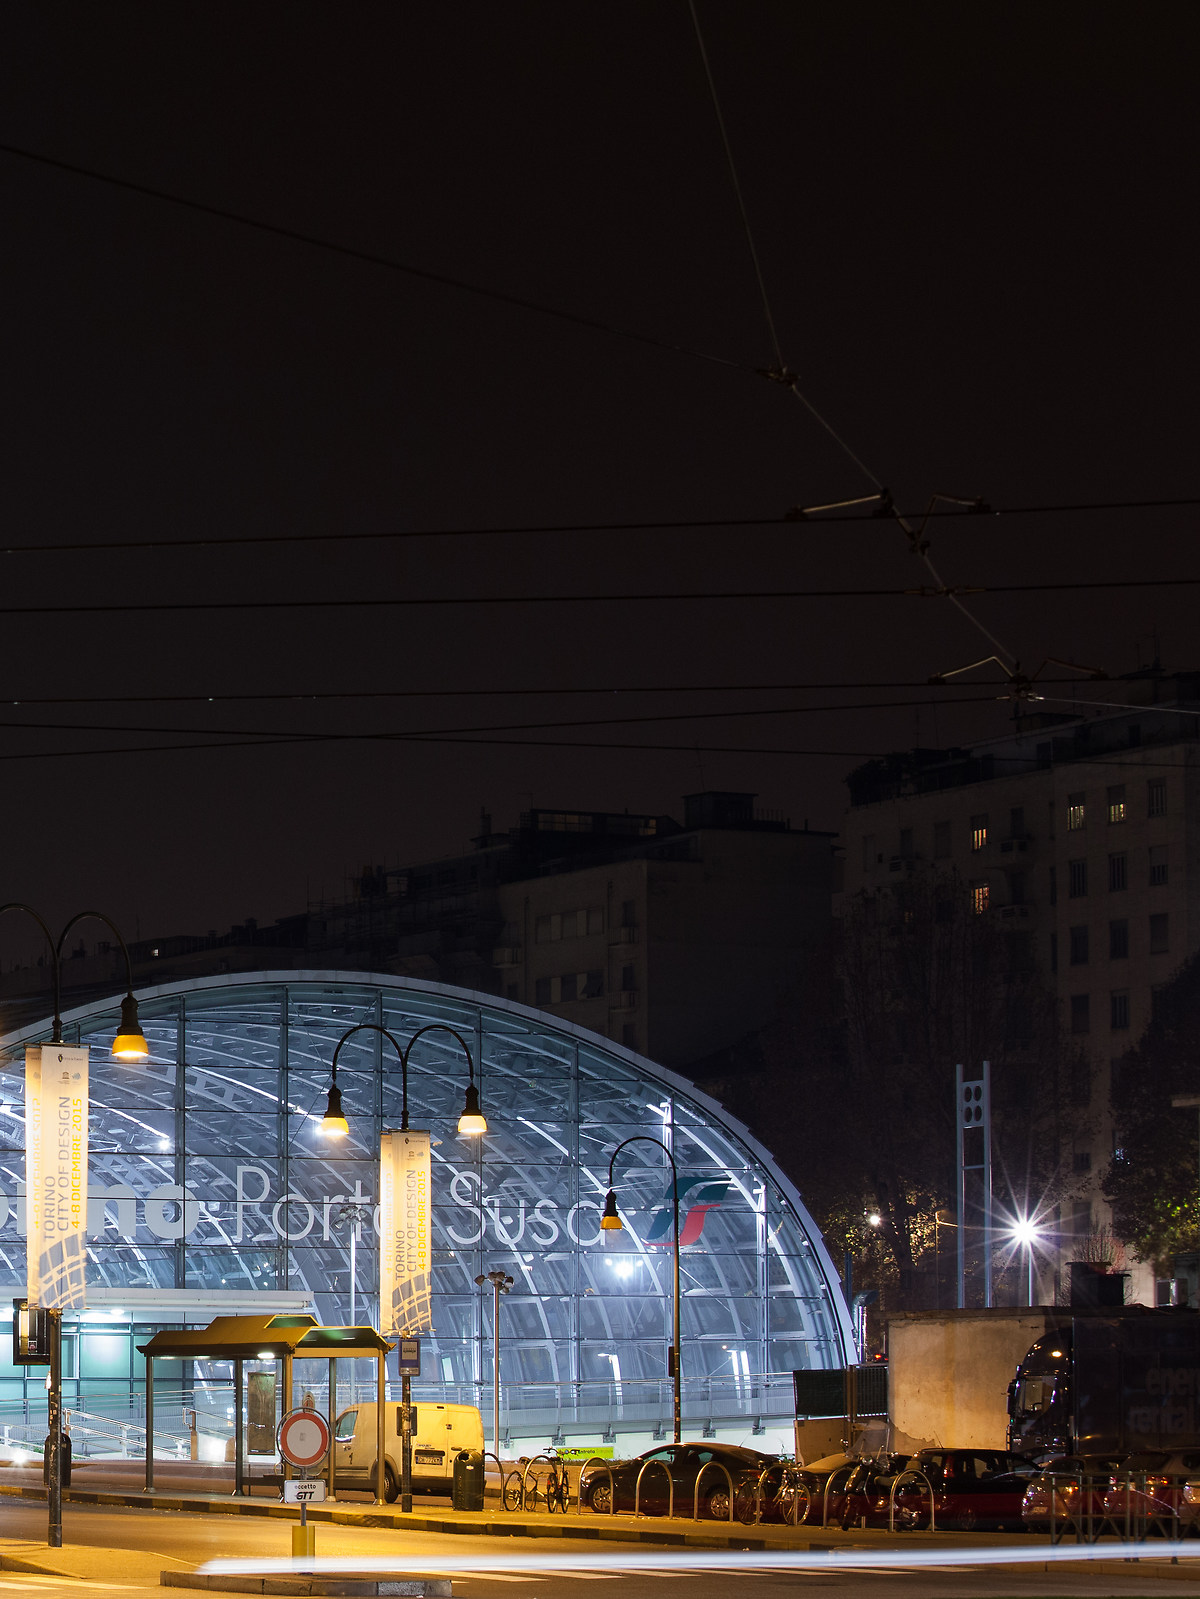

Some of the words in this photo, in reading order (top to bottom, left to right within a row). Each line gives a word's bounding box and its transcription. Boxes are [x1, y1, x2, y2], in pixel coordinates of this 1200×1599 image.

[58, 1096, 70, 1161] DESIGN
[72, 1098, 82, 1132] 2015
[57, 1165, 69, 1188] OF
[71, 1134, 81, 1201] DICEMBRE
[417, 1171, 426, 1196] 2015
[43, 1176, 55, 1242] TORINO
[57, 1192, 69, 1231] CITY
[236, 1165, 380, 1242] Port
[447, 1171, 605, 1247] Susa
[406, 1169, 416, 1218] DESIGN
[71, 1204, 81, 1229] 4-8
[406, 1222, 416, 1239] OF
[417, 1198, 426, 1249] DICEMBRE
[395, 1230, 405, 1281] TORINO
[406, 1242, 416, 1272] CITY
[417, 1250, 426, 1270] 4-8
[296, 1491, 314, 1500] GTT
